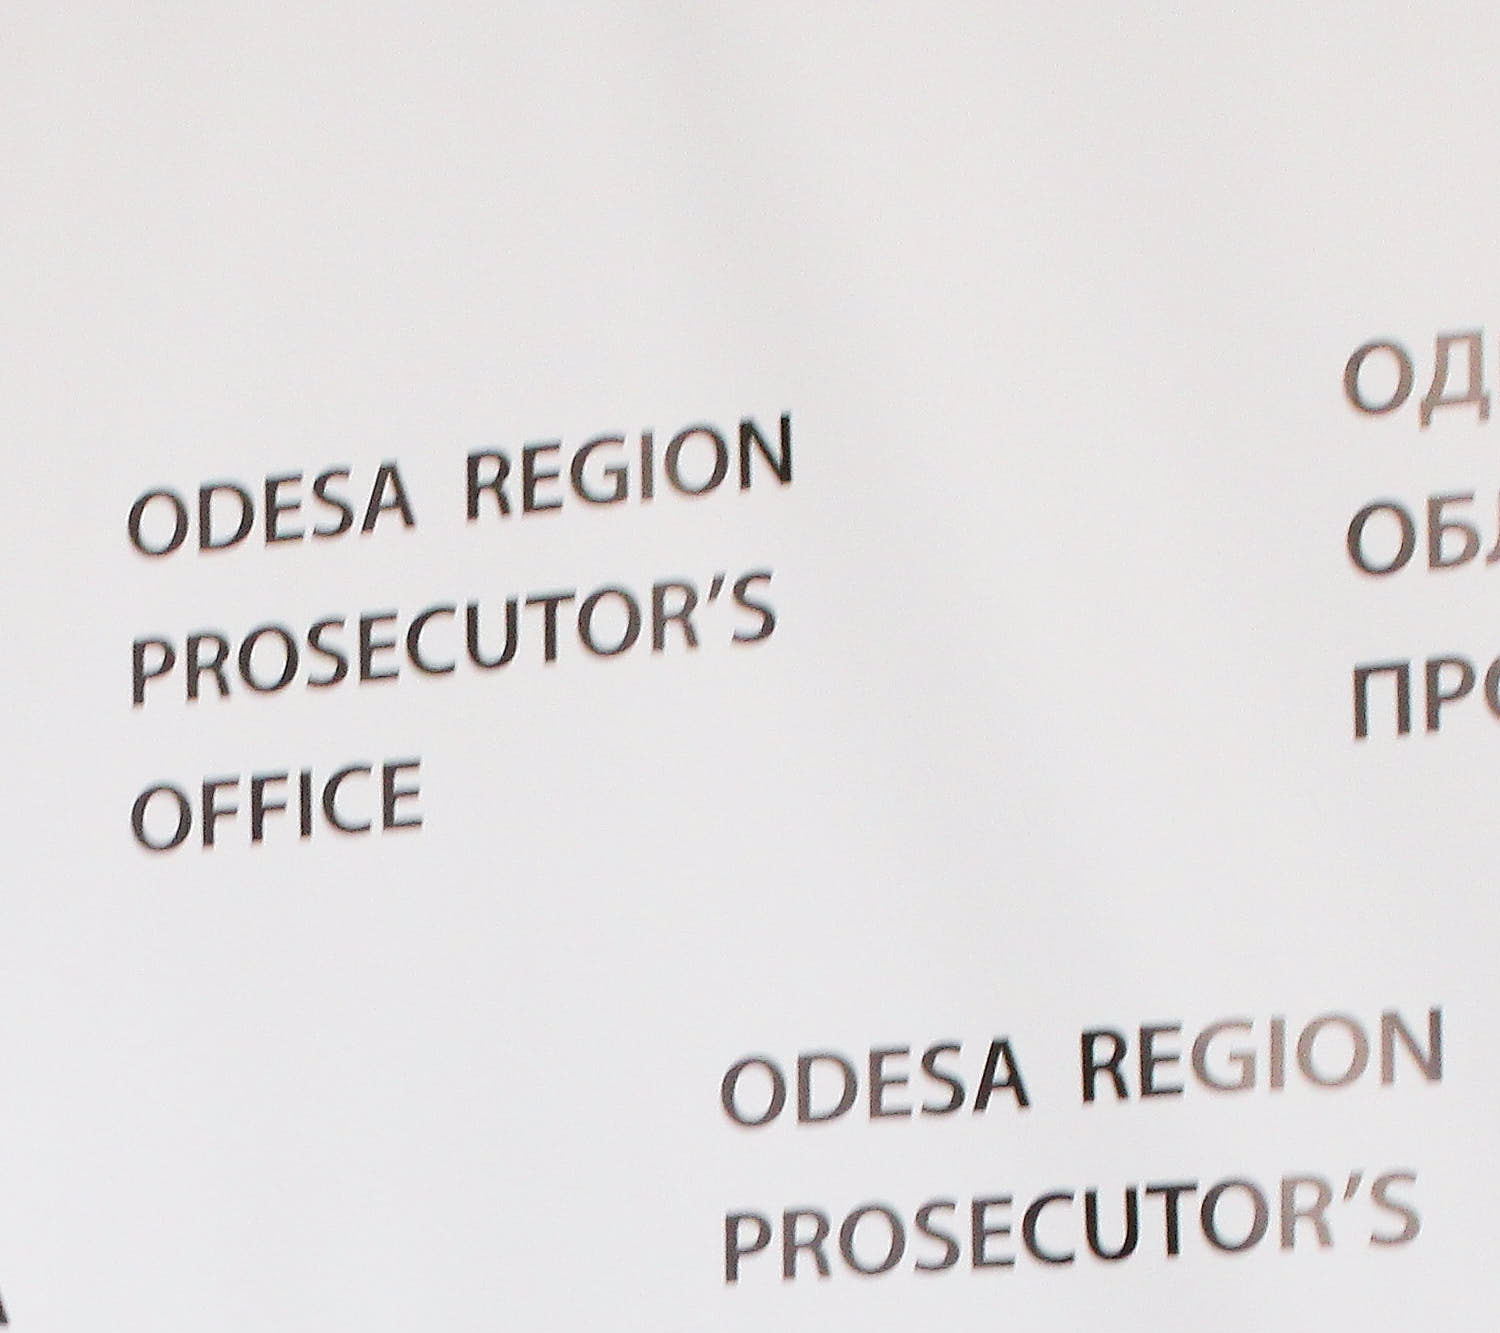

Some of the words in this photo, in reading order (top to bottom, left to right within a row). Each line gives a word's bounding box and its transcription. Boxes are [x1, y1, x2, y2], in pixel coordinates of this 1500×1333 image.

[126, 461, 417, 560] ODESA
[465, 412, 794, 523] REGION
[130, 569, 778, 709] PROSECUTOR'S
[129, 758, 424, 854] OFFICE
[719, 1036, 1032, 1130] ODESA
[1079, 1007, 1444, 1106] REGION
[723, 1172, 1421, 1285] PROSECUTOR'S
